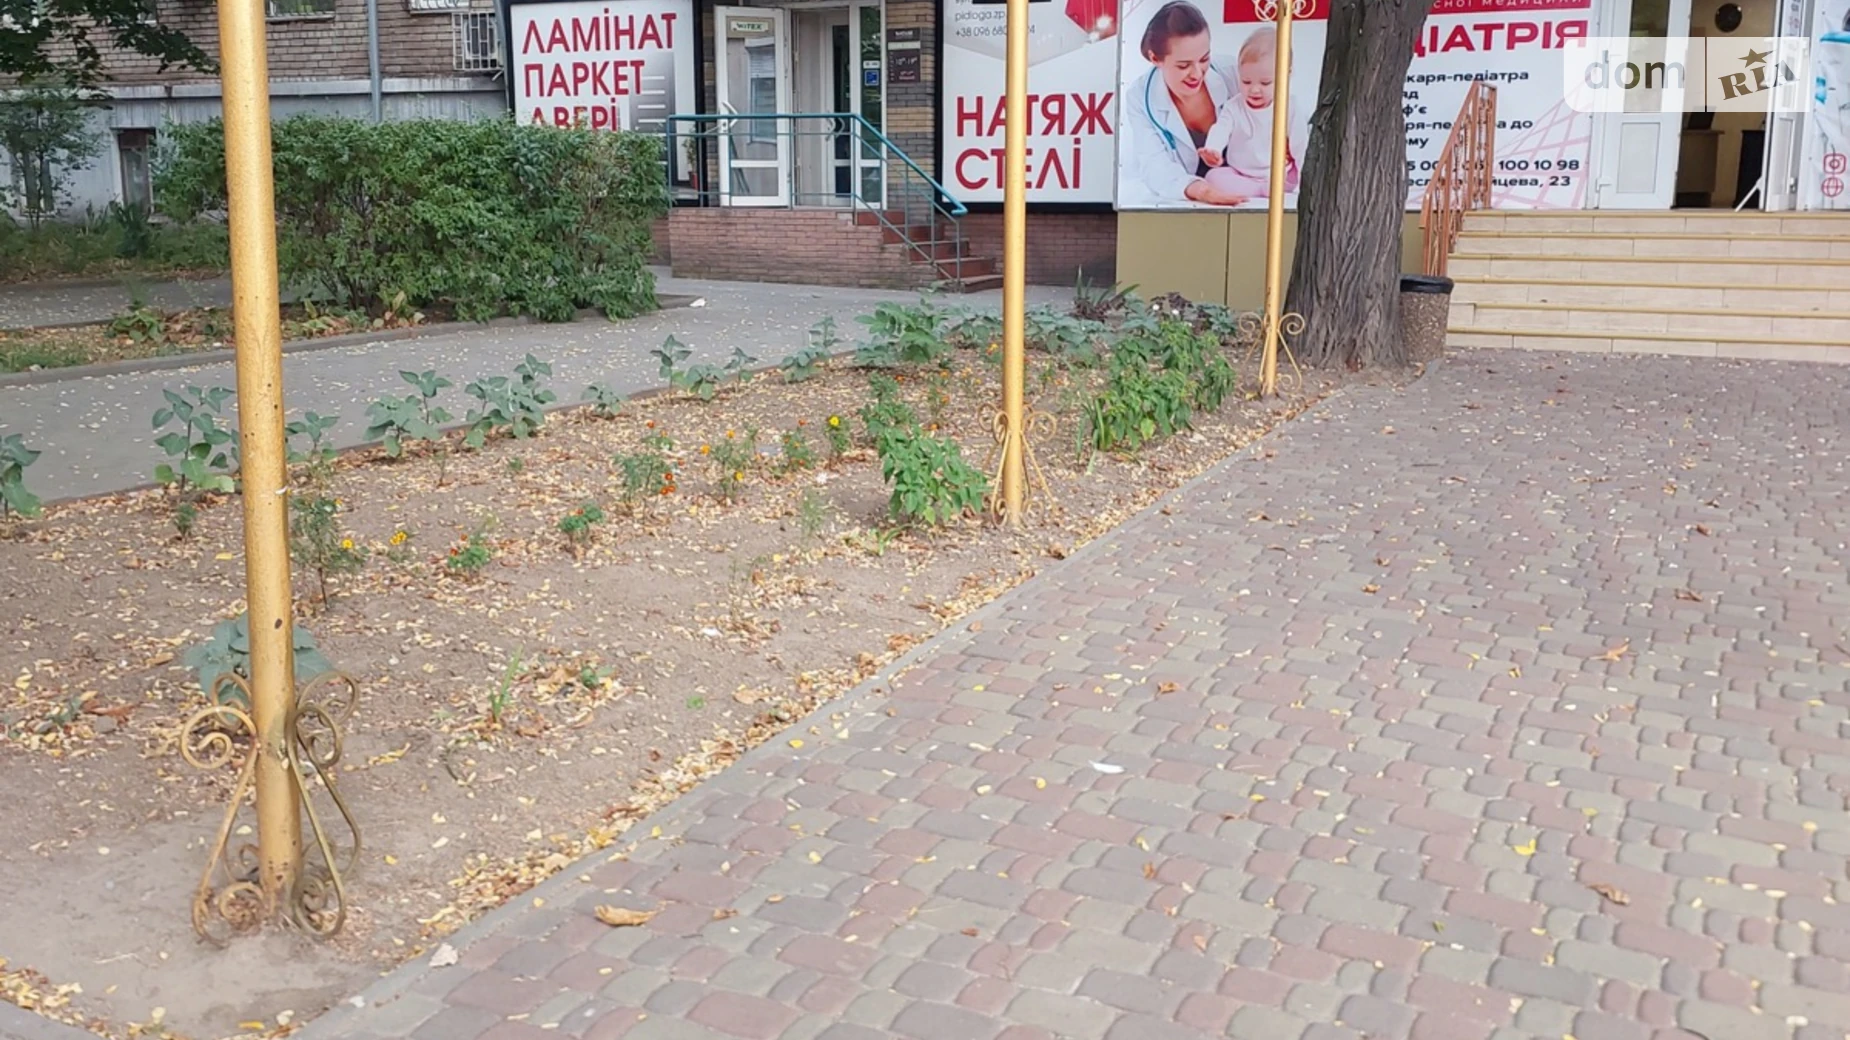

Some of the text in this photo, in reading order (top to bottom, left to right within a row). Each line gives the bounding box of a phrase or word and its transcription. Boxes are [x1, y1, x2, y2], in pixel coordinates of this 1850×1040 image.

[524, 60, 645, 97] ПАРКЕТ
[1406, 70, 1529, 86] каря-педіатра
[1511, 120, 1533, 130] до
[1406, 137, 1429, 149] му
[1498, 160, 1529, 171] 100
[1534, 160, 1552, 171] 10
[1557, 160, 1580, 171] 98
[1549, 175, 1571, 187] 23
